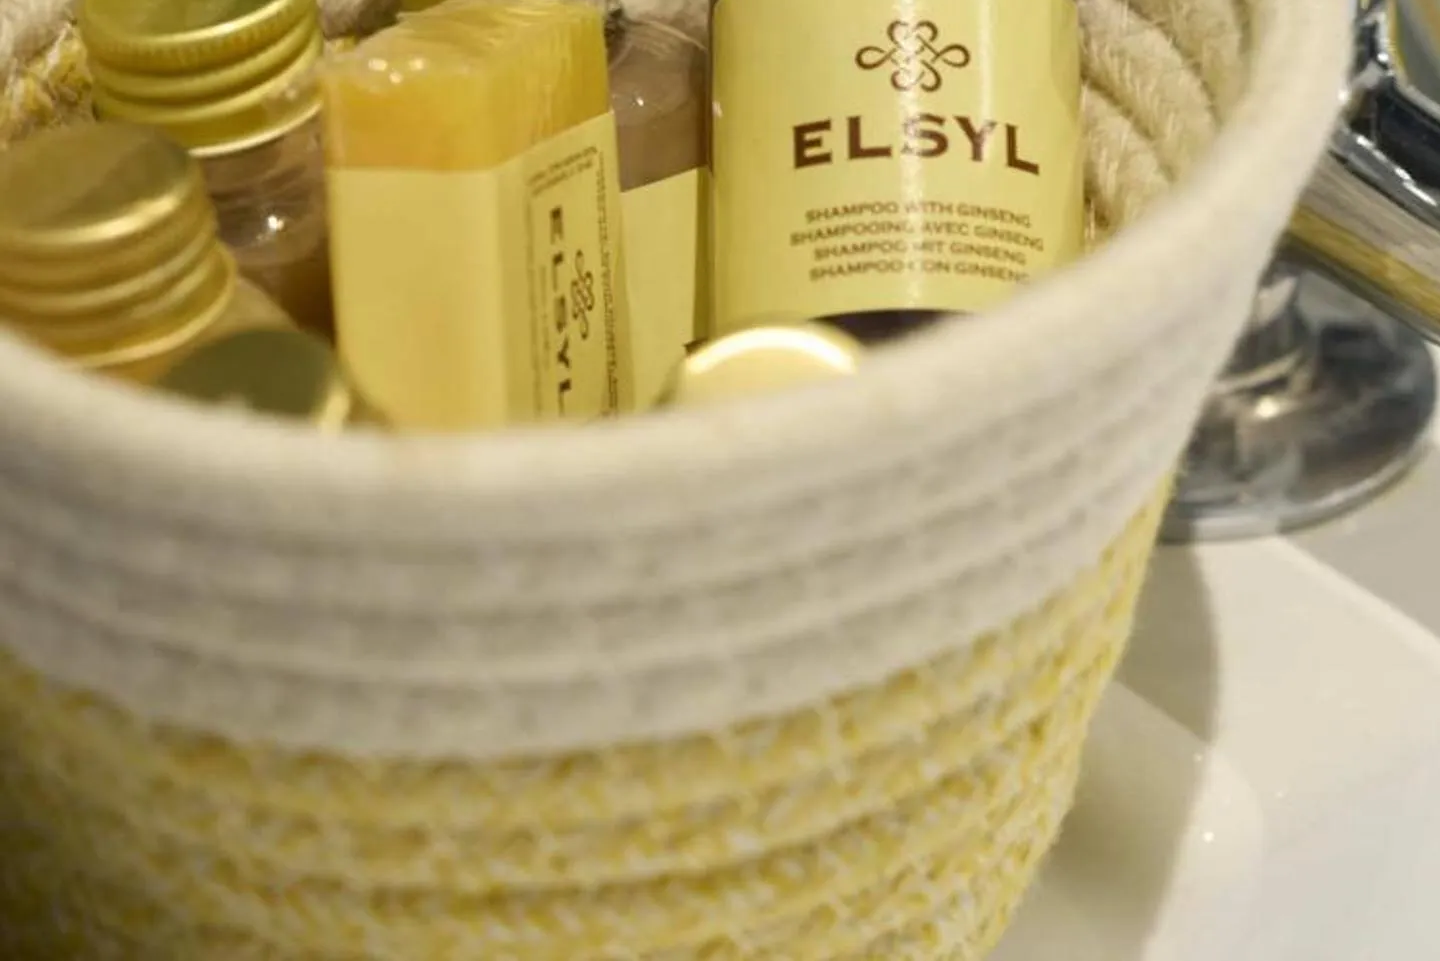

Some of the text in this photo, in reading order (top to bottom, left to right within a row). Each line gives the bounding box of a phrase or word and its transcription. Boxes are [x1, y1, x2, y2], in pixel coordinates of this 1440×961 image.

[793, 112, 1040, 176] ELSYL
[805, 200, 899, 224] SHAMPOO
[957, 202, 1031, 229] GINSENG
[790, 220, 1044, 253] SHAMPOOING AVEC GINSENG
[814, 240, 907, 262] SHAMPOO
[950, 241, 1027, 267] GINSENG
[808, 259, 905, 283] SHAMPOO
[954, 261, 1030, 286] GINSENG
[550, 206, 572, 417] ELSYL
